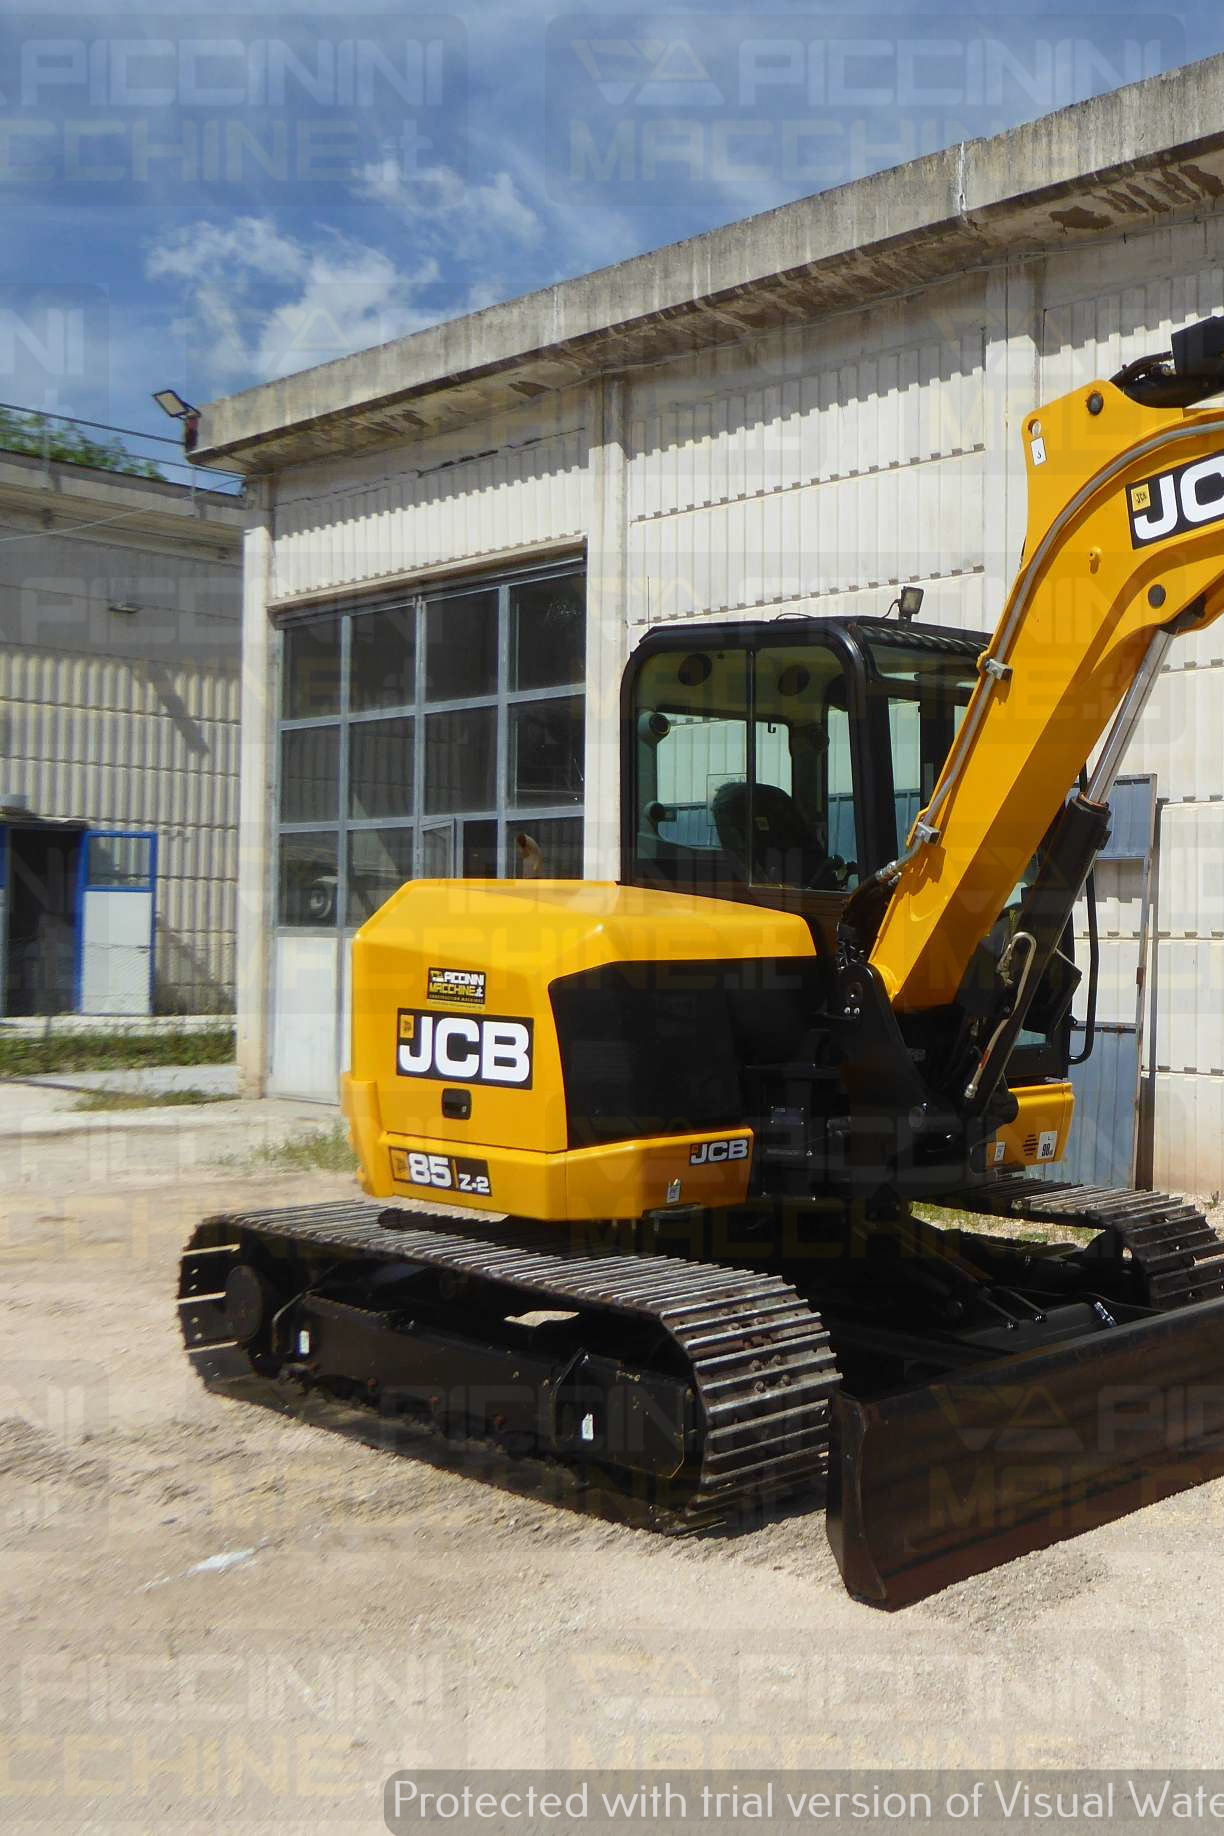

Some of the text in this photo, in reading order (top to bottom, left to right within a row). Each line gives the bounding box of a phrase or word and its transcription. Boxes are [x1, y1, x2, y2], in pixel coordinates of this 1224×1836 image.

[399, 1016, 530, 1082] JCB
[690, 1139, 749, 1164] JCB
[408, 1152, 490, 1193] 85 Z-2
